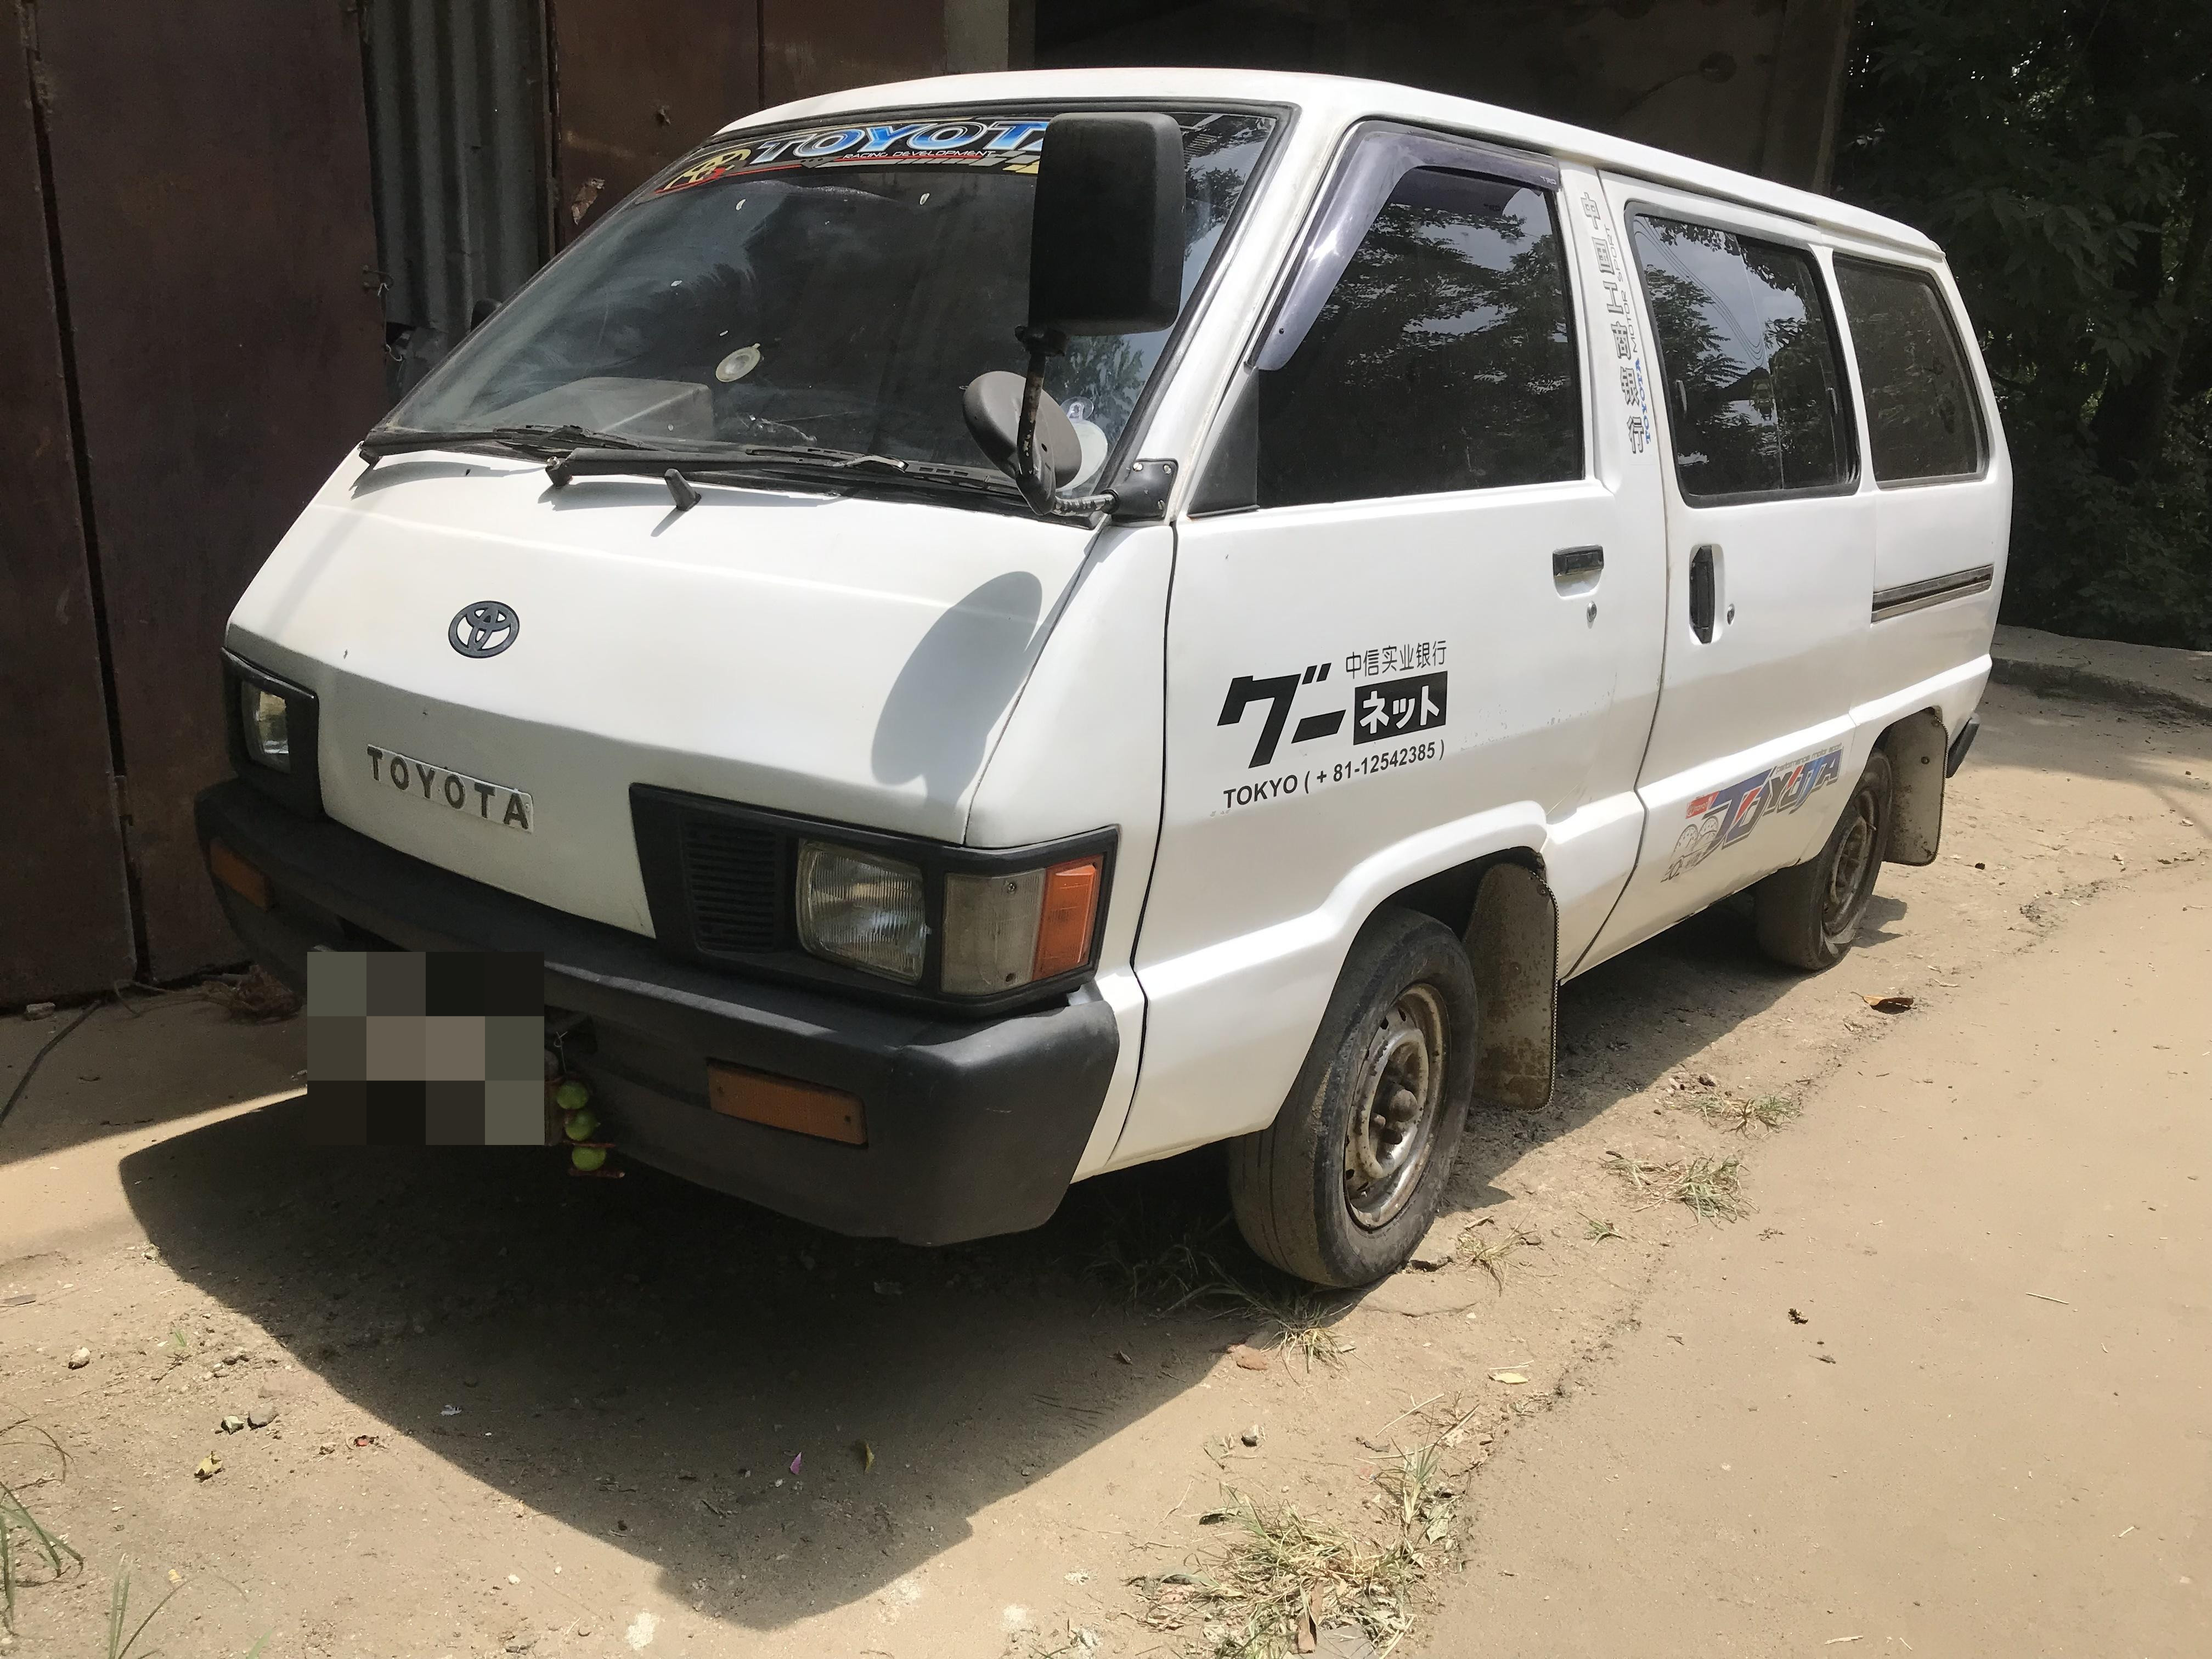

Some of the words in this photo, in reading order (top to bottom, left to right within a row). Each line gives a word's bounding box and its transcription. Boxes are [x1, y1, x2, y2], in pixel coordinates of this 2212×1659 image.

[750, 121, 1051, 165] TOYOT
[1604, 224, 1624, 283] SPORT
[1621, 290, 1638, 353] MOTOR
[1635, 357, 1651, 444] TOYOTA
[1345, 640, 1447, 680] 中信实业银行
[1359, 685, 1440, 735] ネット
[366, 744, 529, 830] TOYOTA
[1223, 774, 1299, 809] TOKYO
[1701, 746, 1844, 857] TOYOTA
